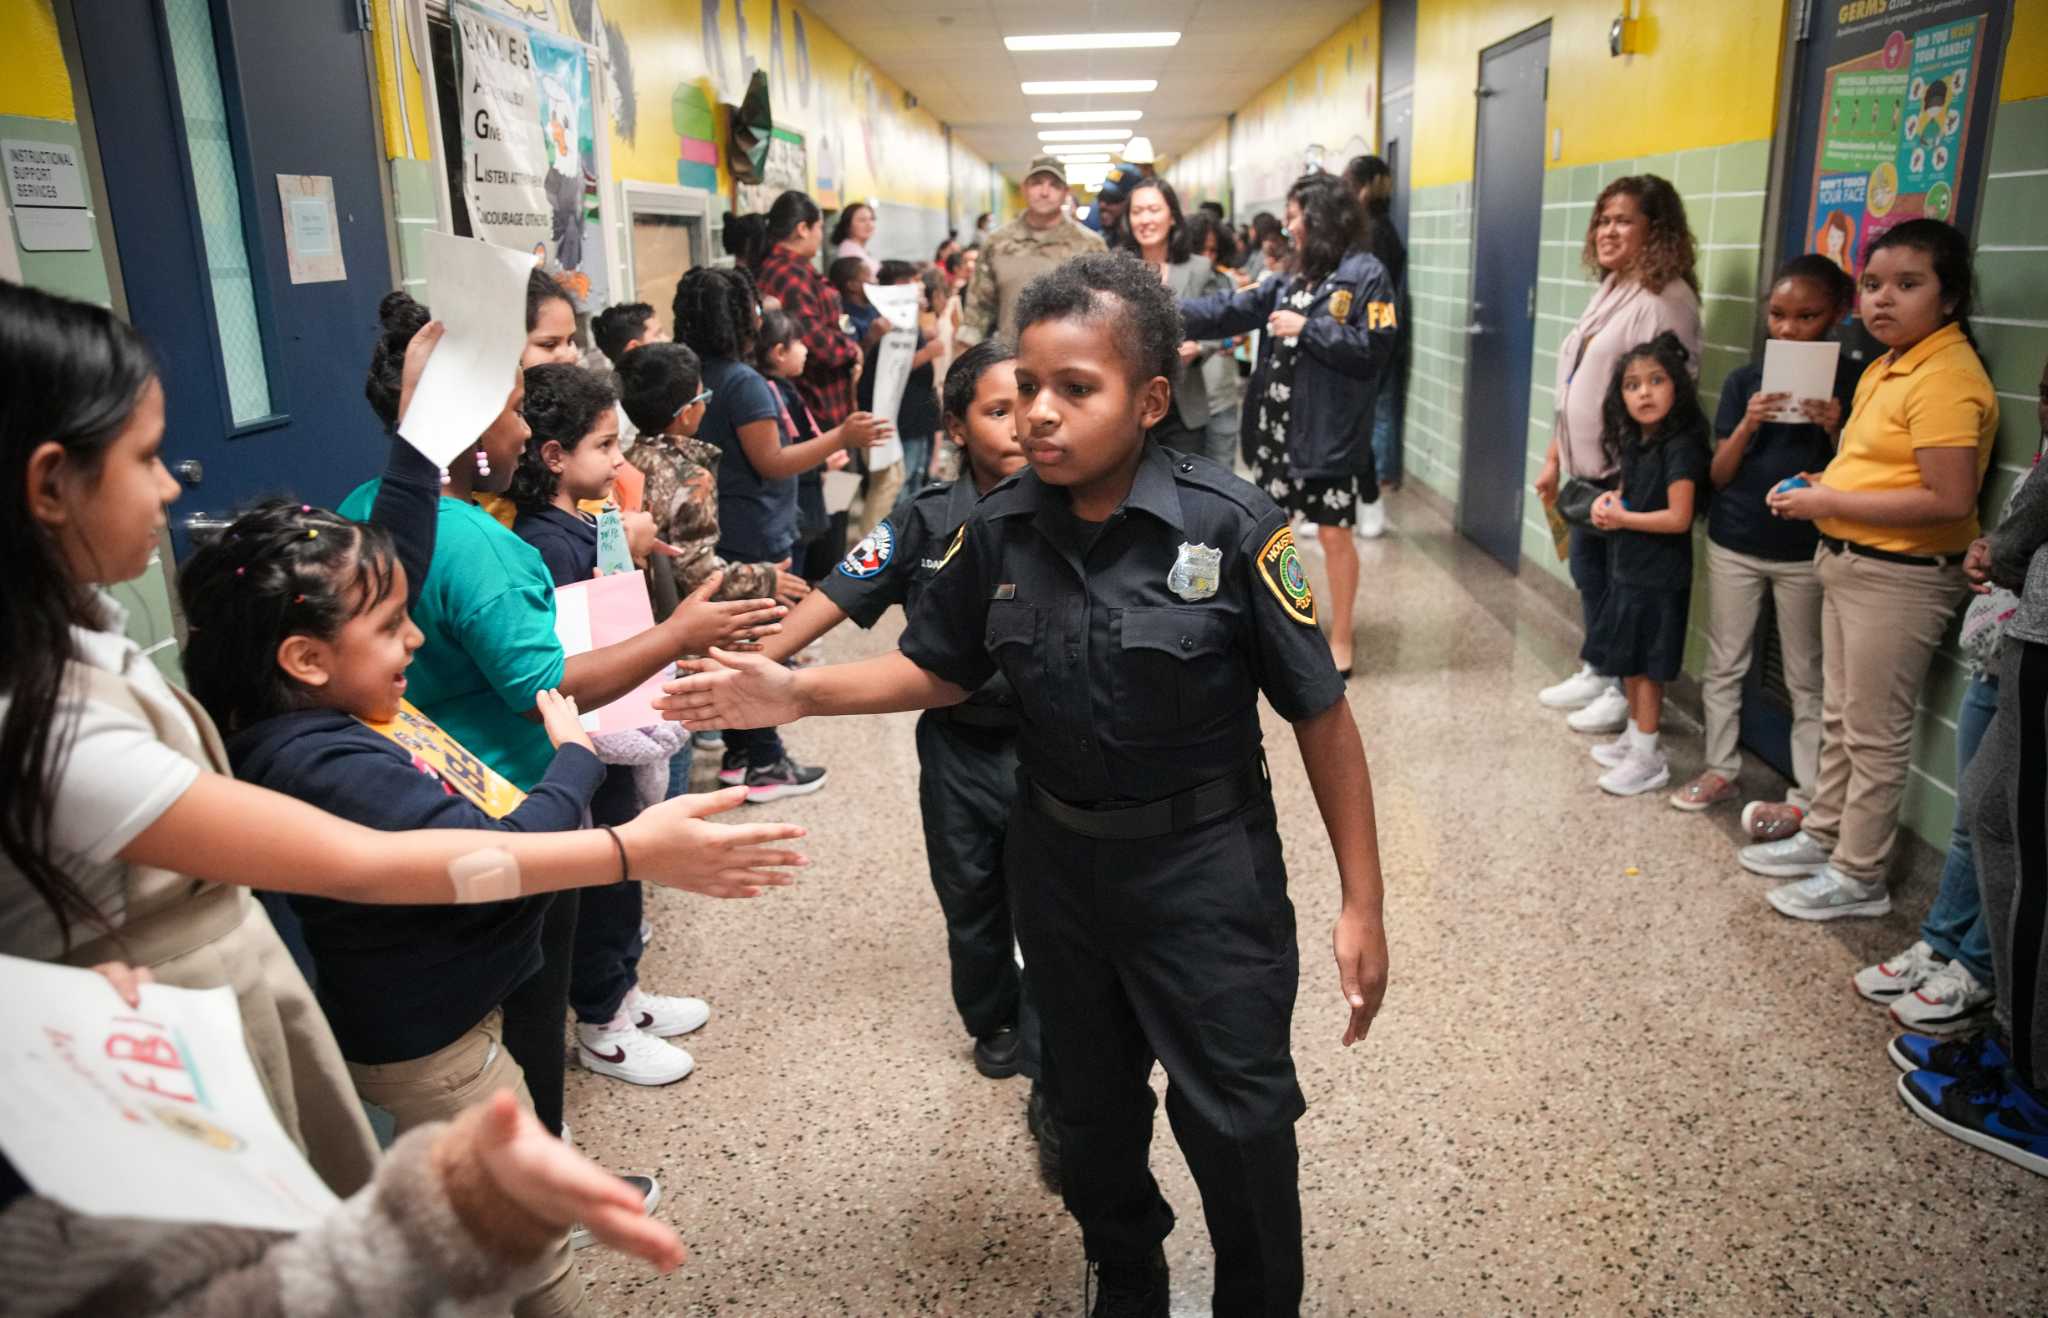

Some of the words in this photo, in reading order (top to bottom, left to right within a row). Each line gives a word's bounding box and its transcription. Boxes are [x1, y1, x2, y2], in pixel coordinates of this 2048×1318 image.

[1838, 0, 1889, 25] GERMS
[10, 149, 74, 166] INSTRUCTIONAL
[13, 166, 51, 181] SUPPORT
[17, 183, 57, 199] SERVICES
[1819, 190, 1842, 205] YOUR
[1843, 187, 1866, 203] FACE
[103, 1016, 199, 1104] FBI
